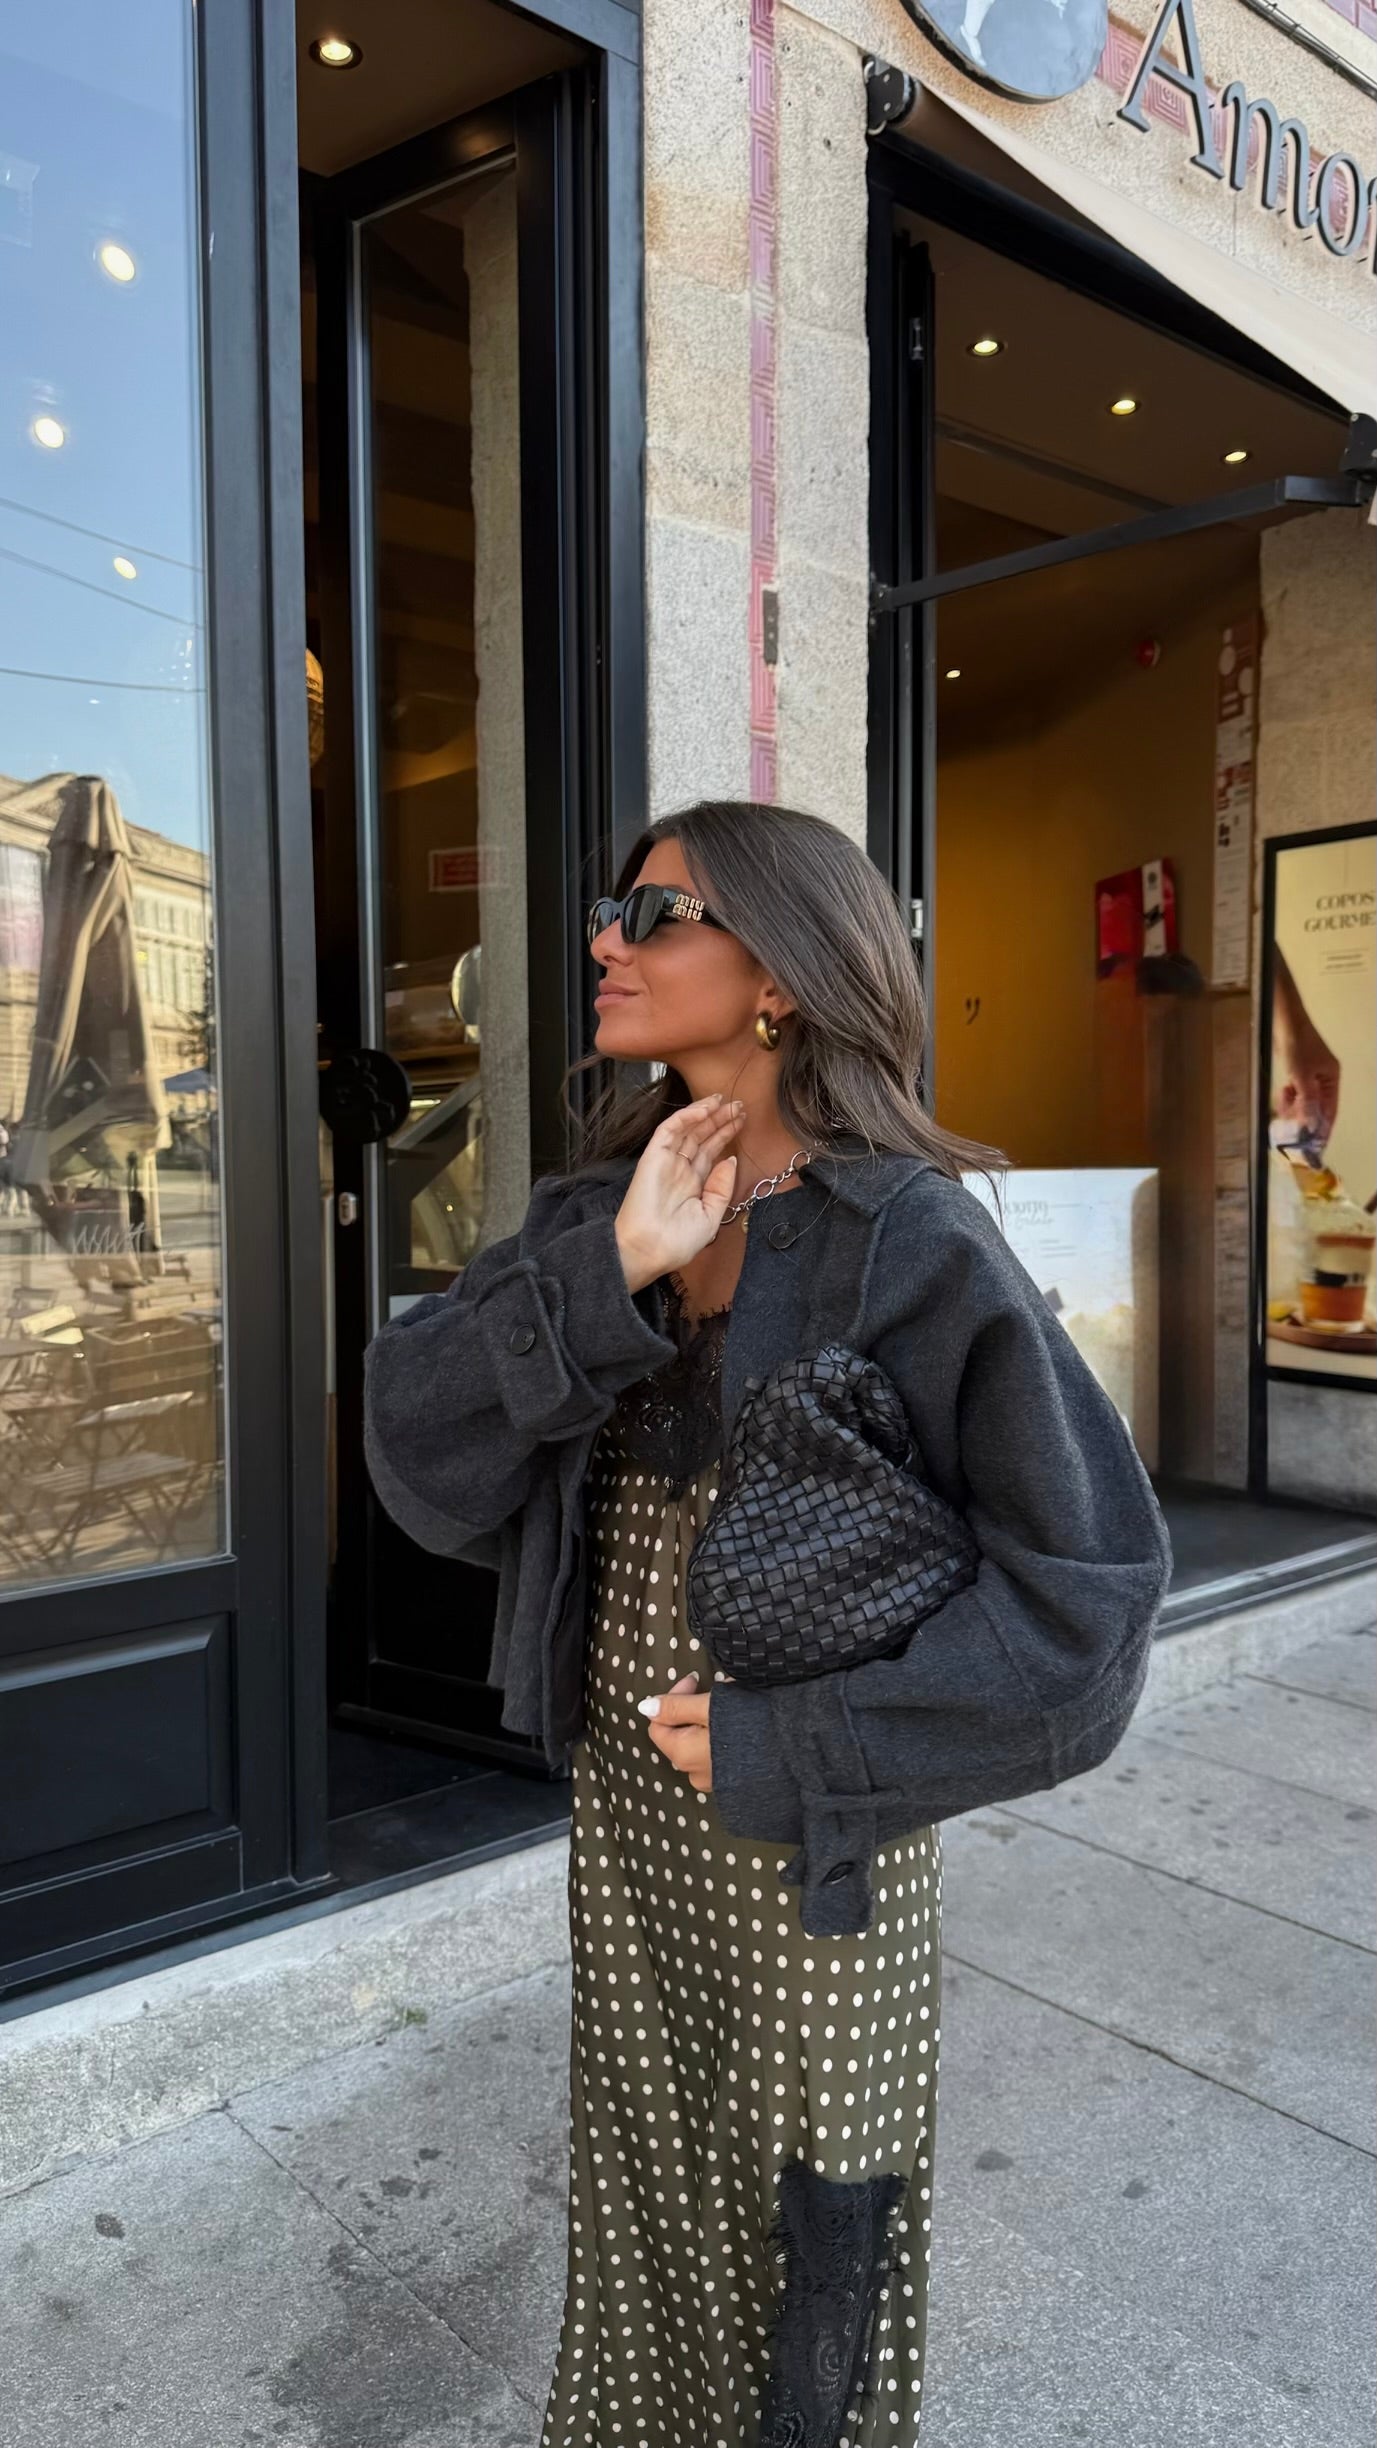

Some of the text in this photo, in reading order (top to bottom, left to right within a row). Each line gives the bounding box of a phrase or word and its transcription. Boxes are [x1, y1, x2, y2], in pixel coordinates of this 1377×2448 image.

[1117, 0, 1377, 275] Amo
[677, 895, 705, 912] miu
[673, 904, 702, 921] miu
